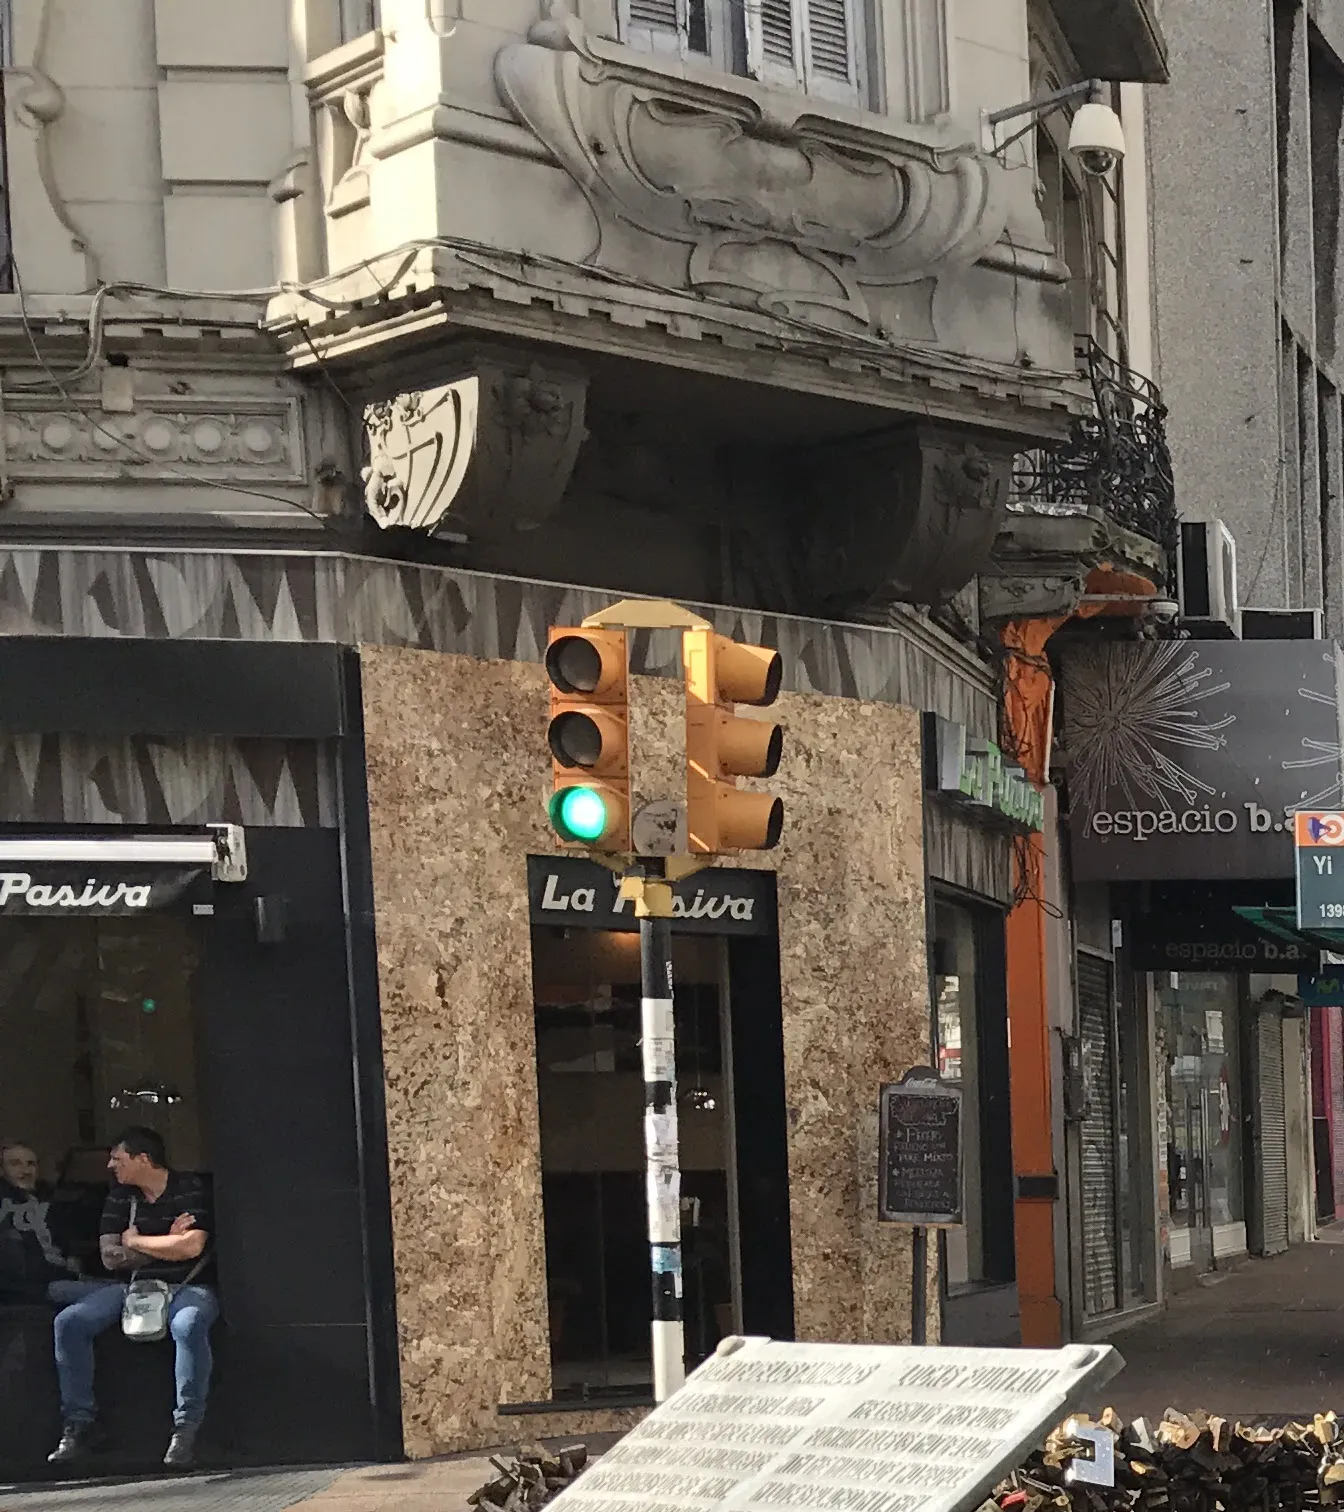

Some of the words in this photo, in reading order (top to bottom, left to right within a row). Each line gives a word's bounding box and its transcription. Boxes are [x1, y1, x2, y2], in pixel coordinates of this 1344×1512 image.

[1092, 804, 1237, 841] espacio
[1313, 855, 1333, 874] Yi
[0, 872, 152, 907] Pasiva
[542, 875, 596, 912] La
[1165, 940, 1257, 962] espacio
